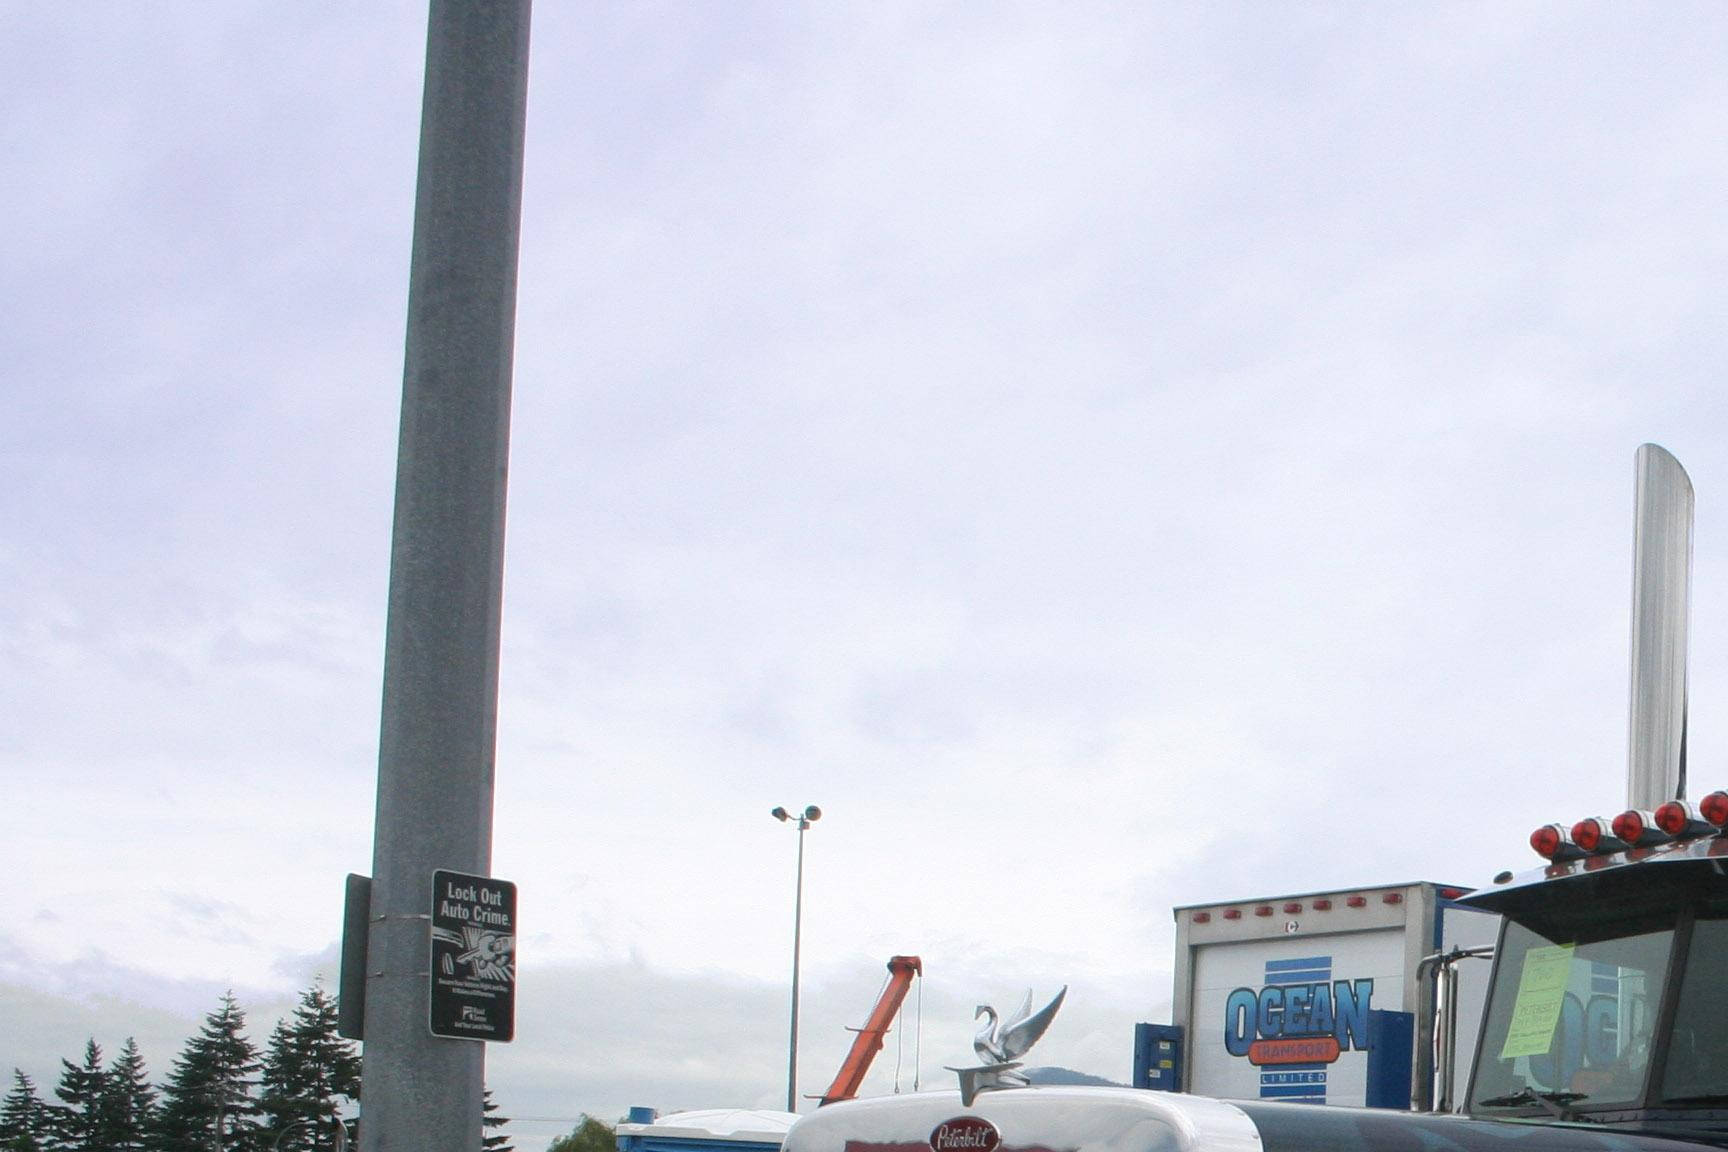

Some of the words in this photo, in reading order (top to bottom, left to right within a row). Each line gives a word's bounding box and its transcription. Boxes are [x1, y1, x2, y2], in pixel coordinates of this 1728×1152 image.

[447, 882, 477, 902] Lock
[481, 887, 502, 907] Out
[440, 900, 470, 920] Auto
[473, 906, 511, 927] Crime.
[1225, 978, 1374, 1057] OCEAN
[1255, 1042, 1332, 1058] TRANSPORT
[1262, 1073, 1325, 1084] LIMITED
[937, 1124, 993, 1150] Peterbilt
